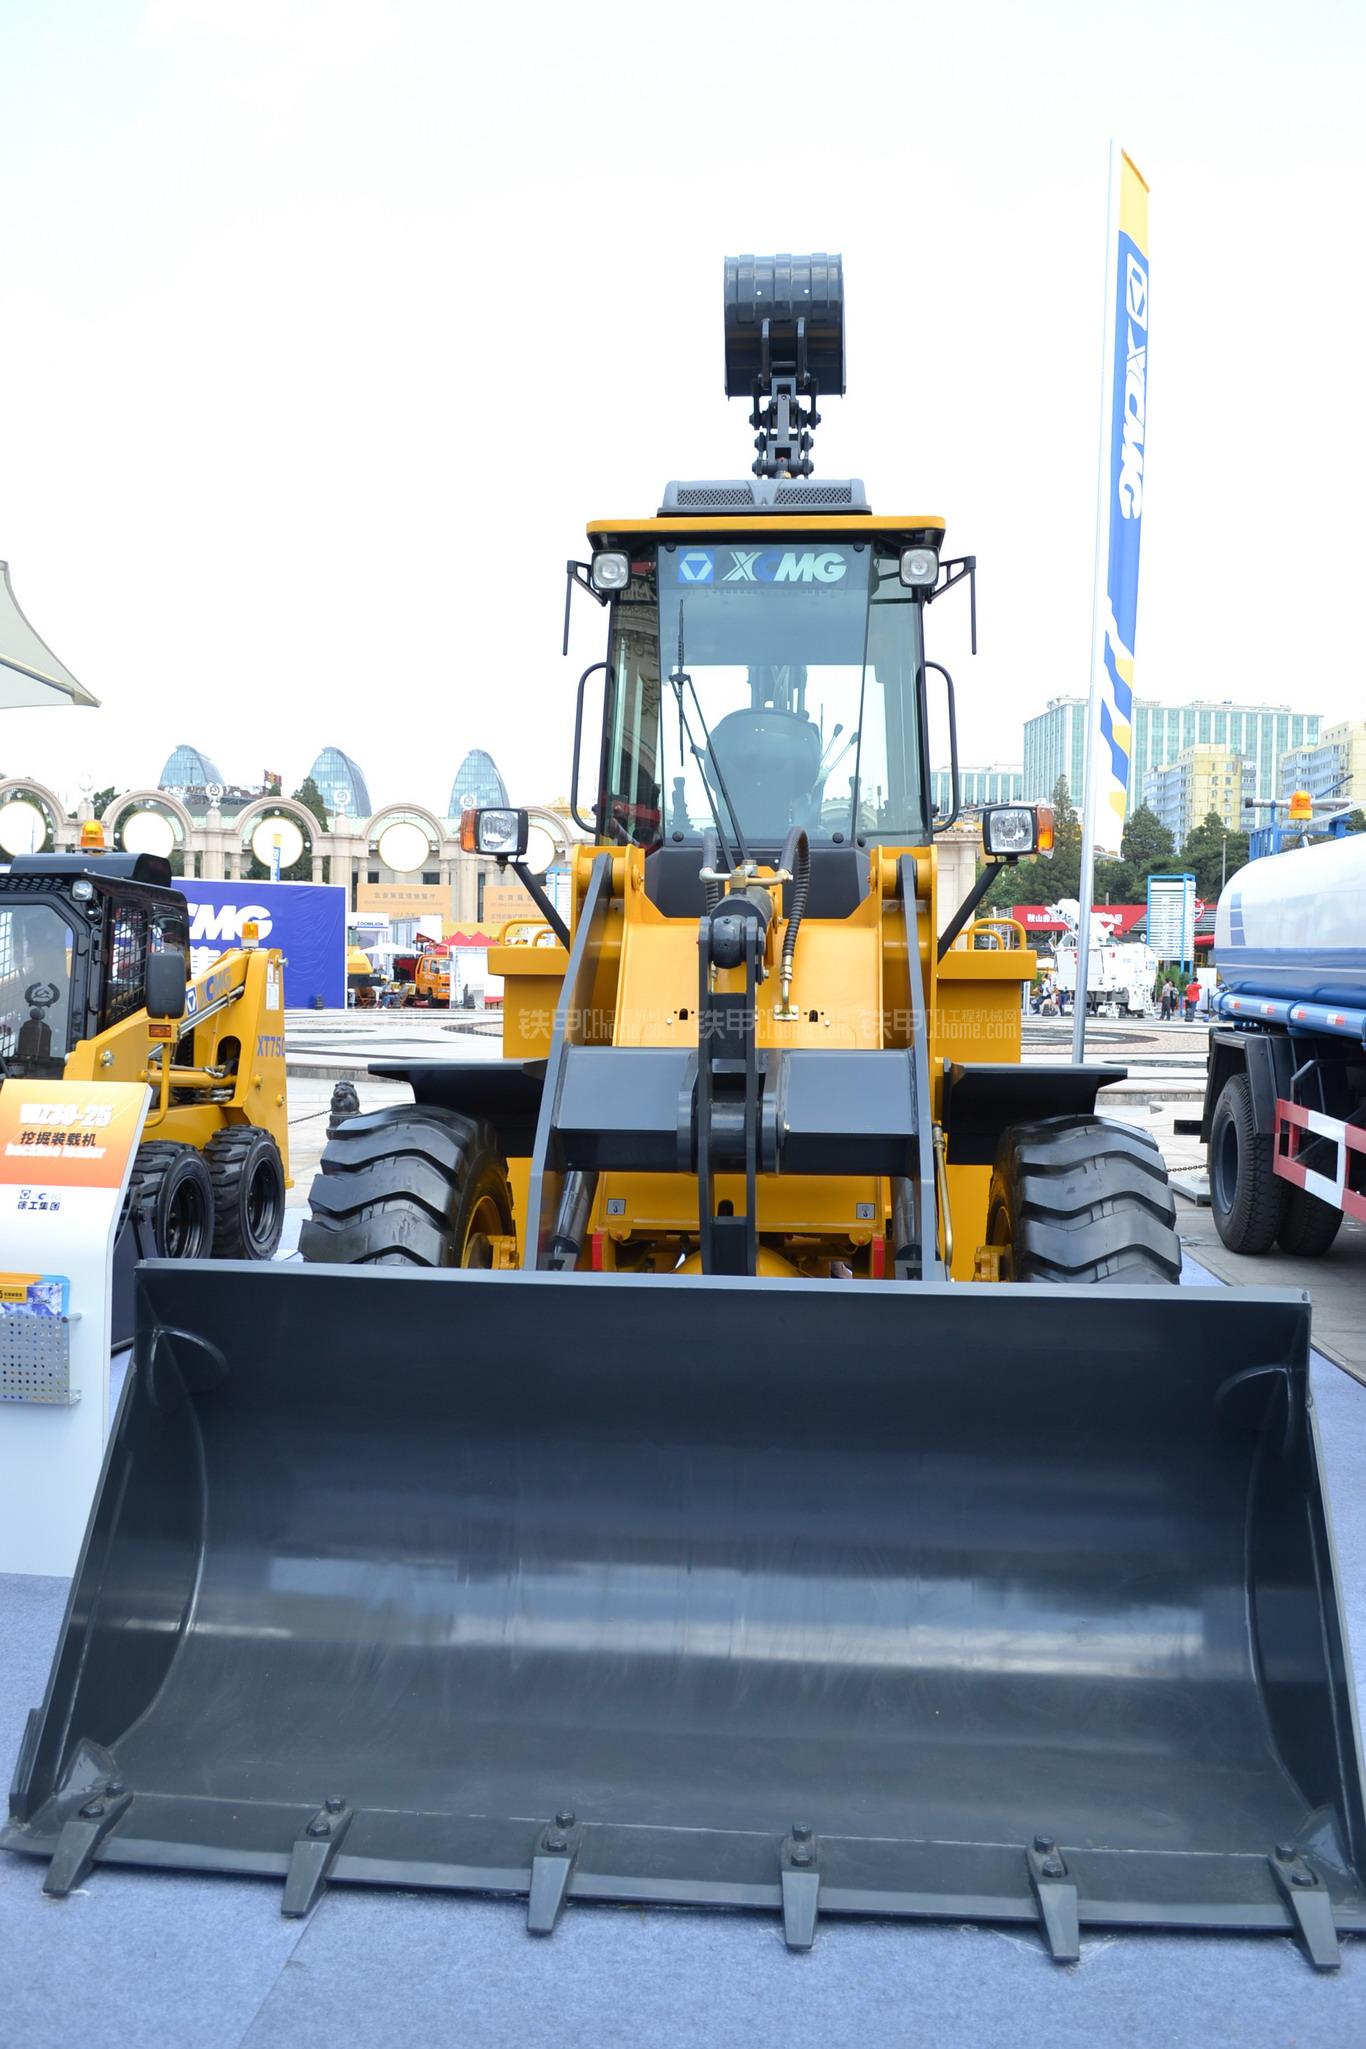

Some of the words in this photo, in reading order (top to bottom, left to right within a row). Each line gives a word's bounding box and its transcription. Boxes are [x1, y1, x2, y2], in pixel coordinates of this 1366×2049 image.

[1118, 318, 1146, 519] XCMG
[722, 551, 847, 583] XCMG
[20, 1131, 97, 1147] 挖掘装载机
[17, 1201, 60, 1211] 徐工集团
